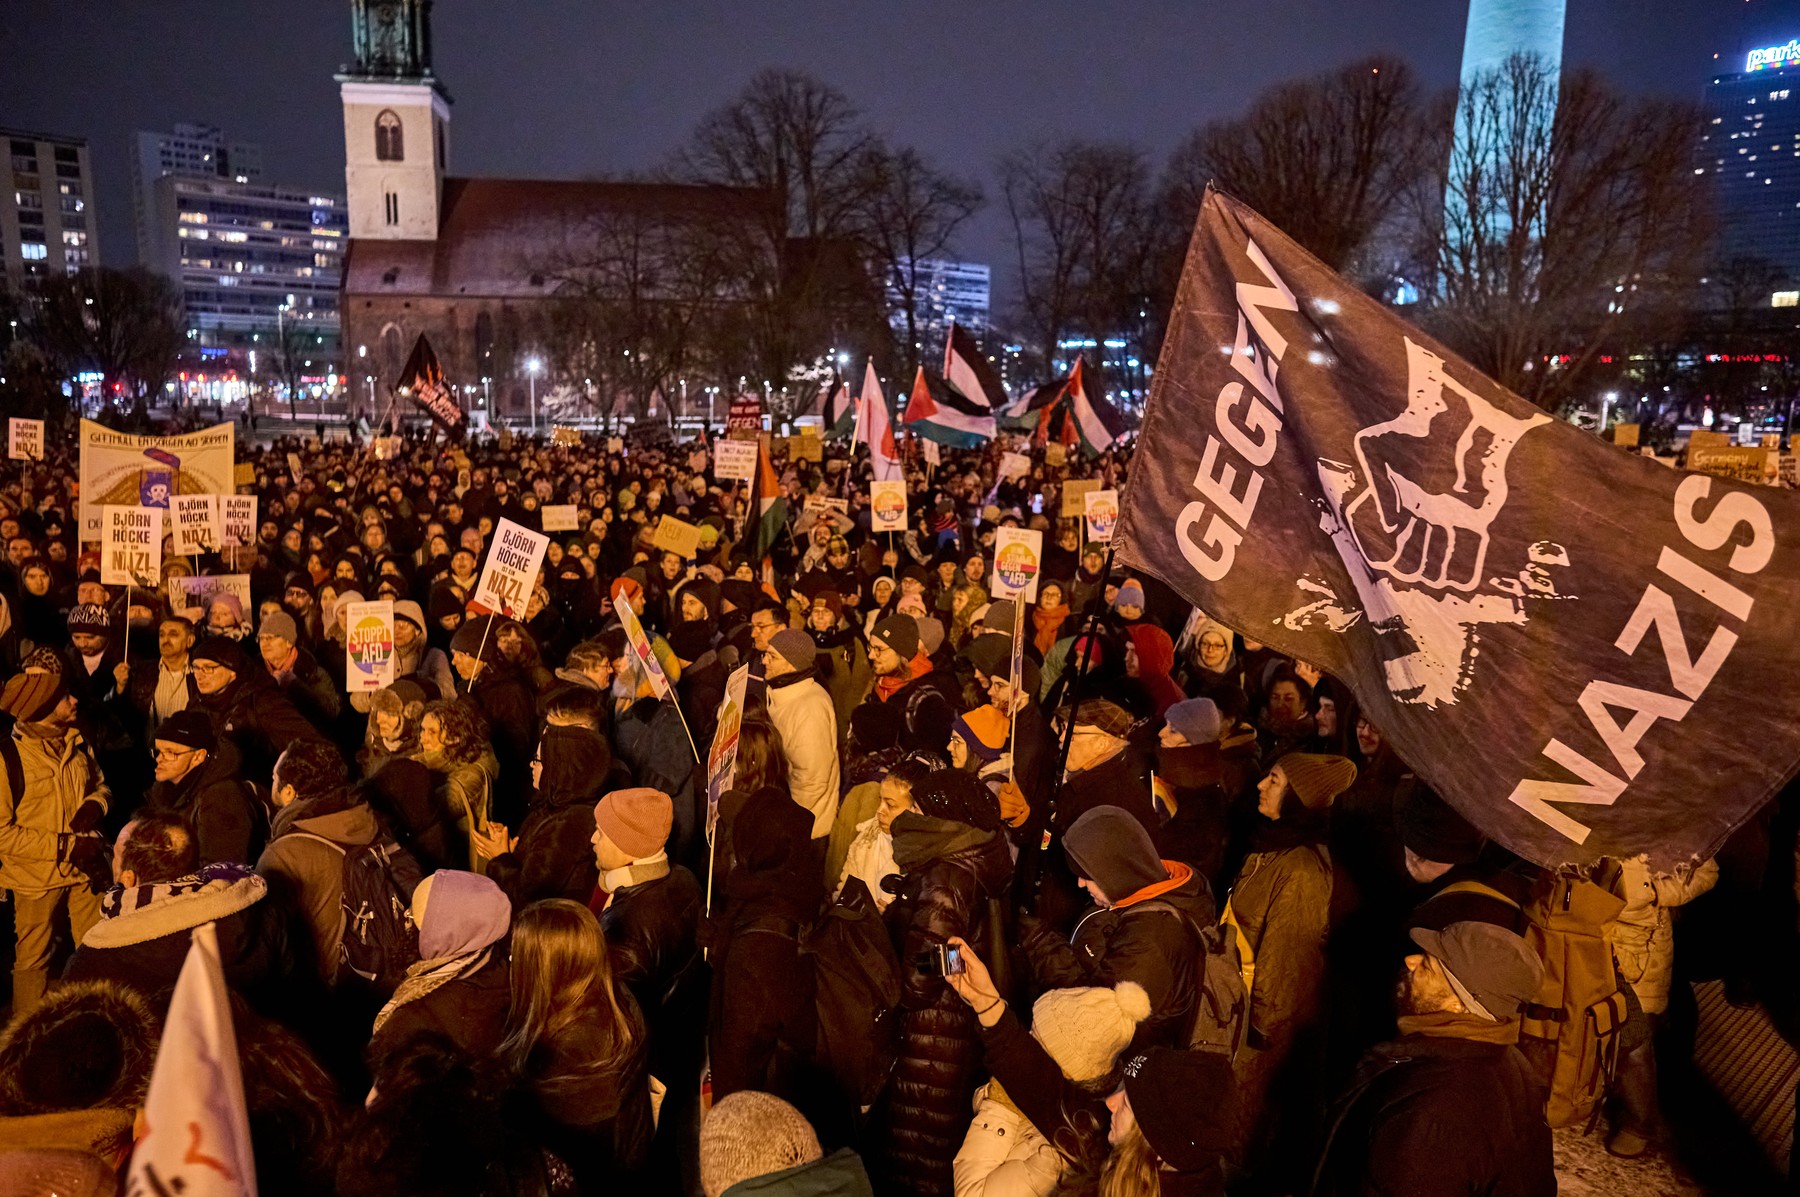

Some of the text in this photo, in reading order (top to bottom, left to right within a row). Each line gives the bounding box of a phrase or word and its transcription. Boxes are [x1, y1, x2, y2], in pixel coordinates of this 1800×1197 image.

[1175, 238, 1298, 582] GEGEN
[1694, 450, 1749, 467] Germany
[178, 497, 208, 511] BJÖRN
[227, 499, 251, 509] BJÖRN
[113, 511, 151, 527] BJÖRN
[180, 511, 209, 524] HÖCKE
[226, 510, 250, 519] HÖCKE
[112, 526, 150, 544] HÖCKE
[182, 528, 212, 544] NAZI
[226, 524, 250, 538] NAZI
[502, 529, 536, 555] BJÖRN
[112, 550, 150, 571] NAZI
[496, 546, 531, 573] HÖCKE
[486, 568, 523, 604] NAZI
[1008, 572, 1026, 586] AFD
[351, 625, 388, 645] STOPPT
[362, 643, 384, 665] AFD
[1508, 475, 1775, 844] NAZIS
